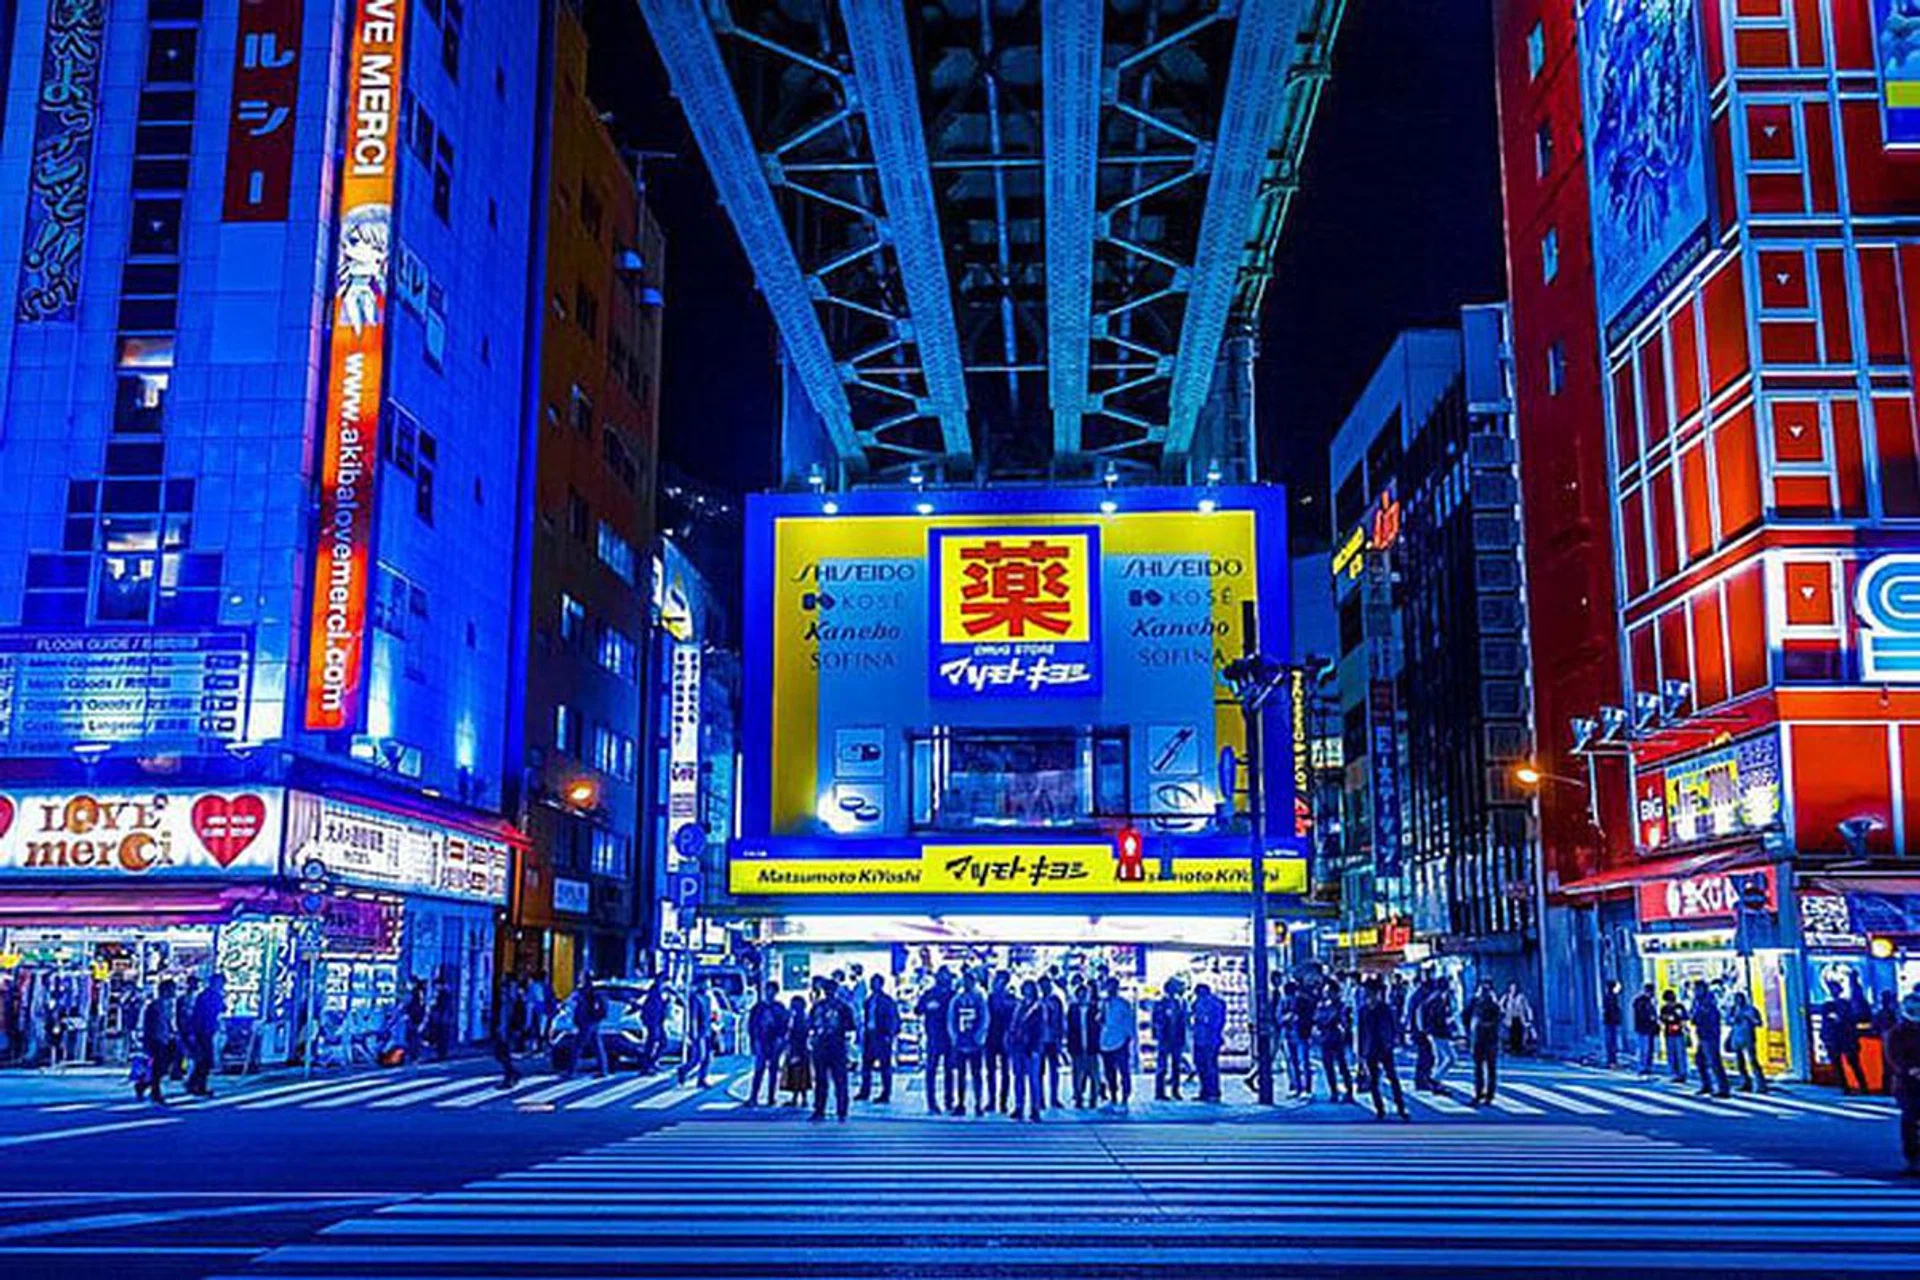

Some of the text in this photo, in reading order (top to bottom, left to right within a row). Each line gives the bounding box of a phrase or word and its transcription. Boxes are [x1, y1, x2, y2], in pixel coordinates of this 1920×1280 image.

[353, 54, 394, 176] MERCI
[322, 352, 364, 712] www.akibalovemerci.com
[791, 564, 915, 583] SHISEIDO
[1122, 559, 1243, 578] SHISEIDO
[960, 540, 1072, 637] 薬
[803, 621, 901, 641] Kanebo
[1131, 616, 1230, 637] Kanebo
[36, 637, 84, 650] FLOOR
[86, 637, 129, 650] GUIDE
[810, 652, 896, 669] SOFINA
[1137, 647, 1226, 667] SOFINA
[940, 657, 1091, 692] マツモトキヨシ
[38, 794, 162, 835] LOVE
[757, 869, 856, 884] Matsumoto
[945, 855, 1090, 887] マツモトキヨシ
[681, 877, 698, 906] P
